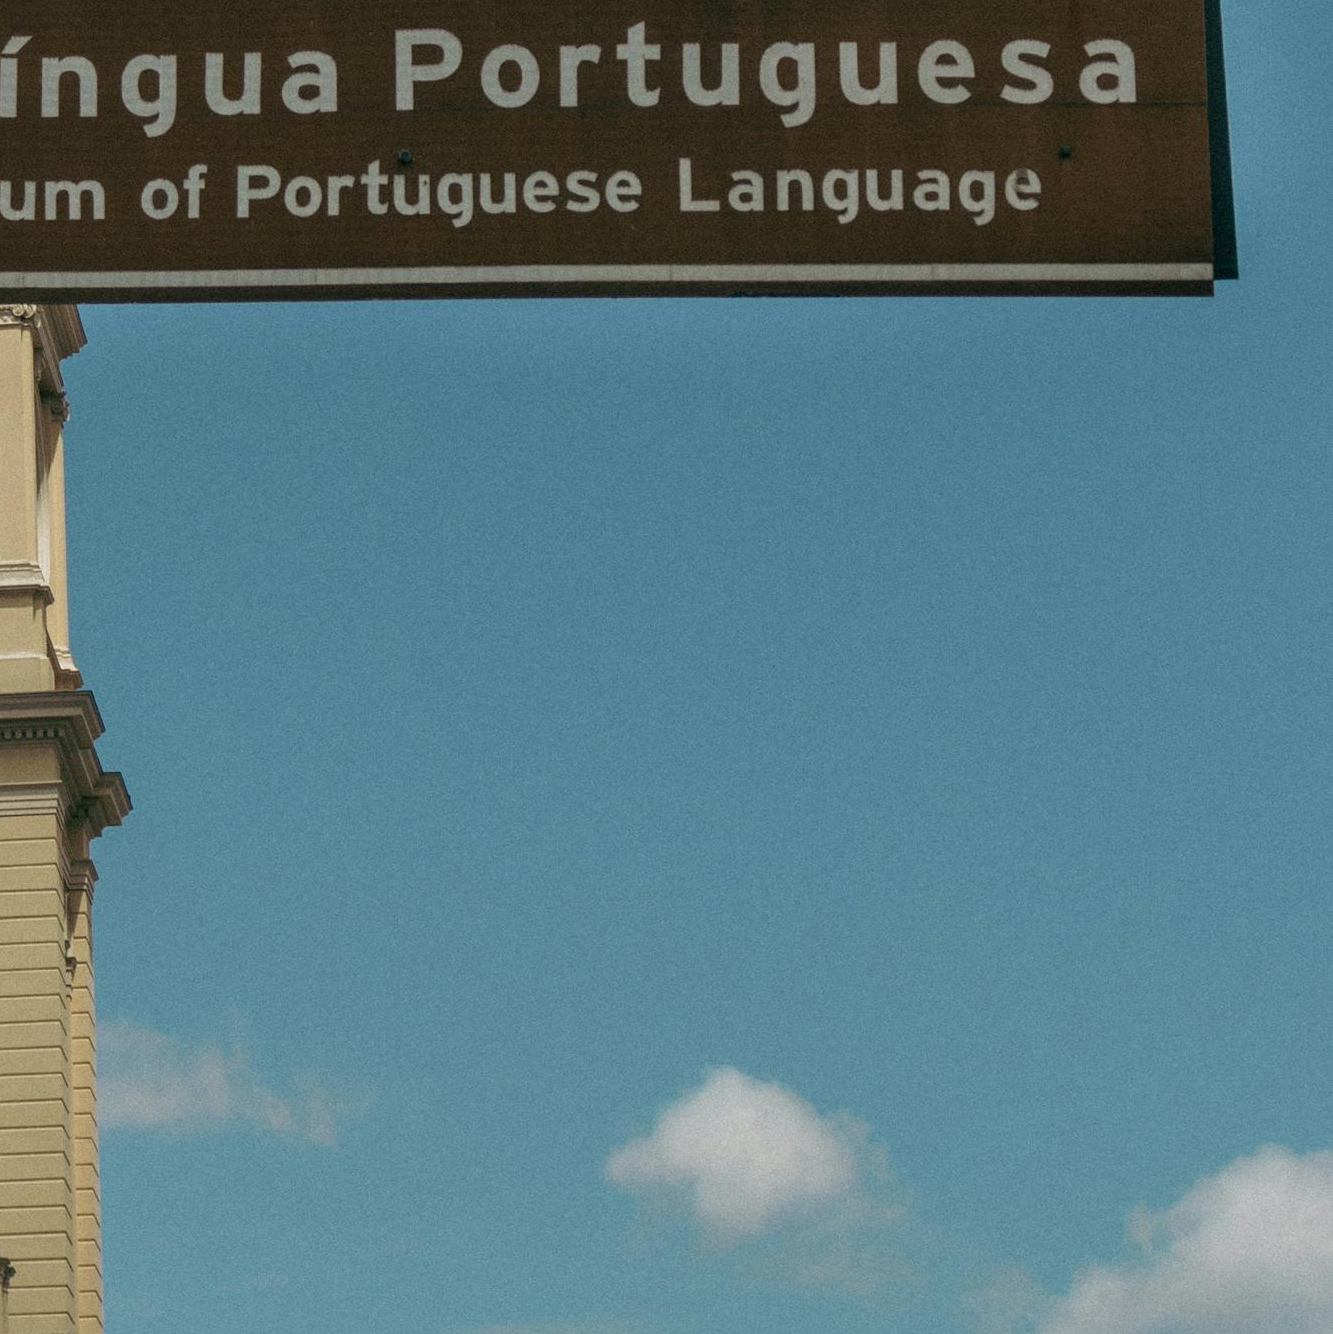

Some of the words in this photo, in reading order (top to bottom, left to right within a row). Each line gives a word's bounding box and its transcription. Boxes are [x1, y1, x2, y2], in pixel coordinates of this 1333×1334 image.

[394, 21, 1137, 128] Portuguesa
[140, 163, 208, 220] of
[236, 159, 643, 228] Portuguese
[678, 157, 1042, 226] Language
